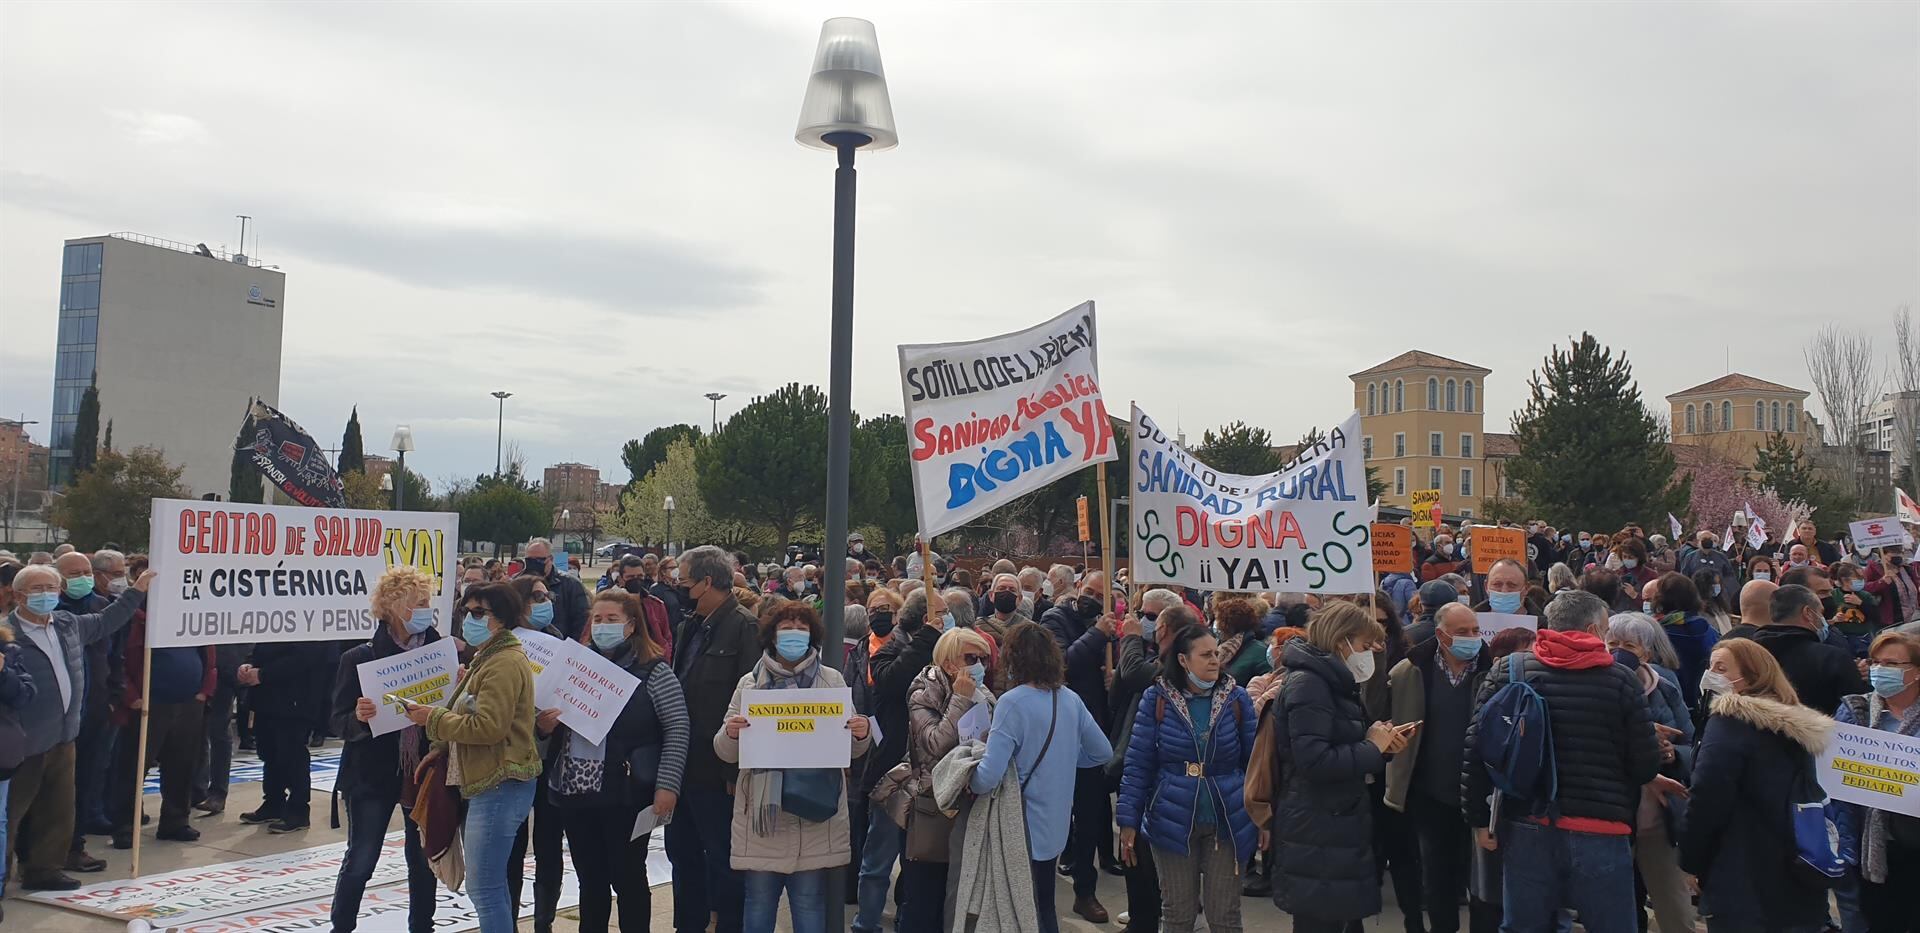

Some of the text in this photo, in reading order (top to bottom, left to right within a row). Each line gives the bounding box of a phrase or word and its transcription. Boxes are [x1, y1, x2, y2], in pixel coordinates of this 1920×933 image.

[1059, 398, 1114, 462] YA
[1137, 449, 1357, 516] SANIDAD RURAL
[178, 508, 277, 555] CENTRO
[284, 526, 306, 556] DE
[313, 515, 382, 558] SALUD
[1175, 505, 1308, 550] DIGNA
[1136, 509, 1185, 578] SOS
[1301, 511, 1370, 589] SOS
[183, 568, 203, 584] EN
[209, 560, 368, 598] CISTÉRNIGA
[182, 585, 201, 601] LA
[175, 611, 297, 637] JUBILADOS
[303, 610, 316, 633] Y
[376, 661, 413, 678] SOMOS
[565, 656, 598, 681] SANIDAD
[598, 676, 625, 699] RURAL
[383, 679, 399, 690] NO
[563, 692, 599, 719] CALIDAD
[748, 705, 843, 716] SANIDAD RURAL
[777, 721, 815, 731] DIGNA
[1838, 732, 1880, 747] SOMOS
[1840, 746, 1856, 757] NO
[1833, 759, 1920, 784] NECESITAMOS
[1842, 775, 1904, 795] PEDIATRA
[147, 866, 260, 889] DUELE
